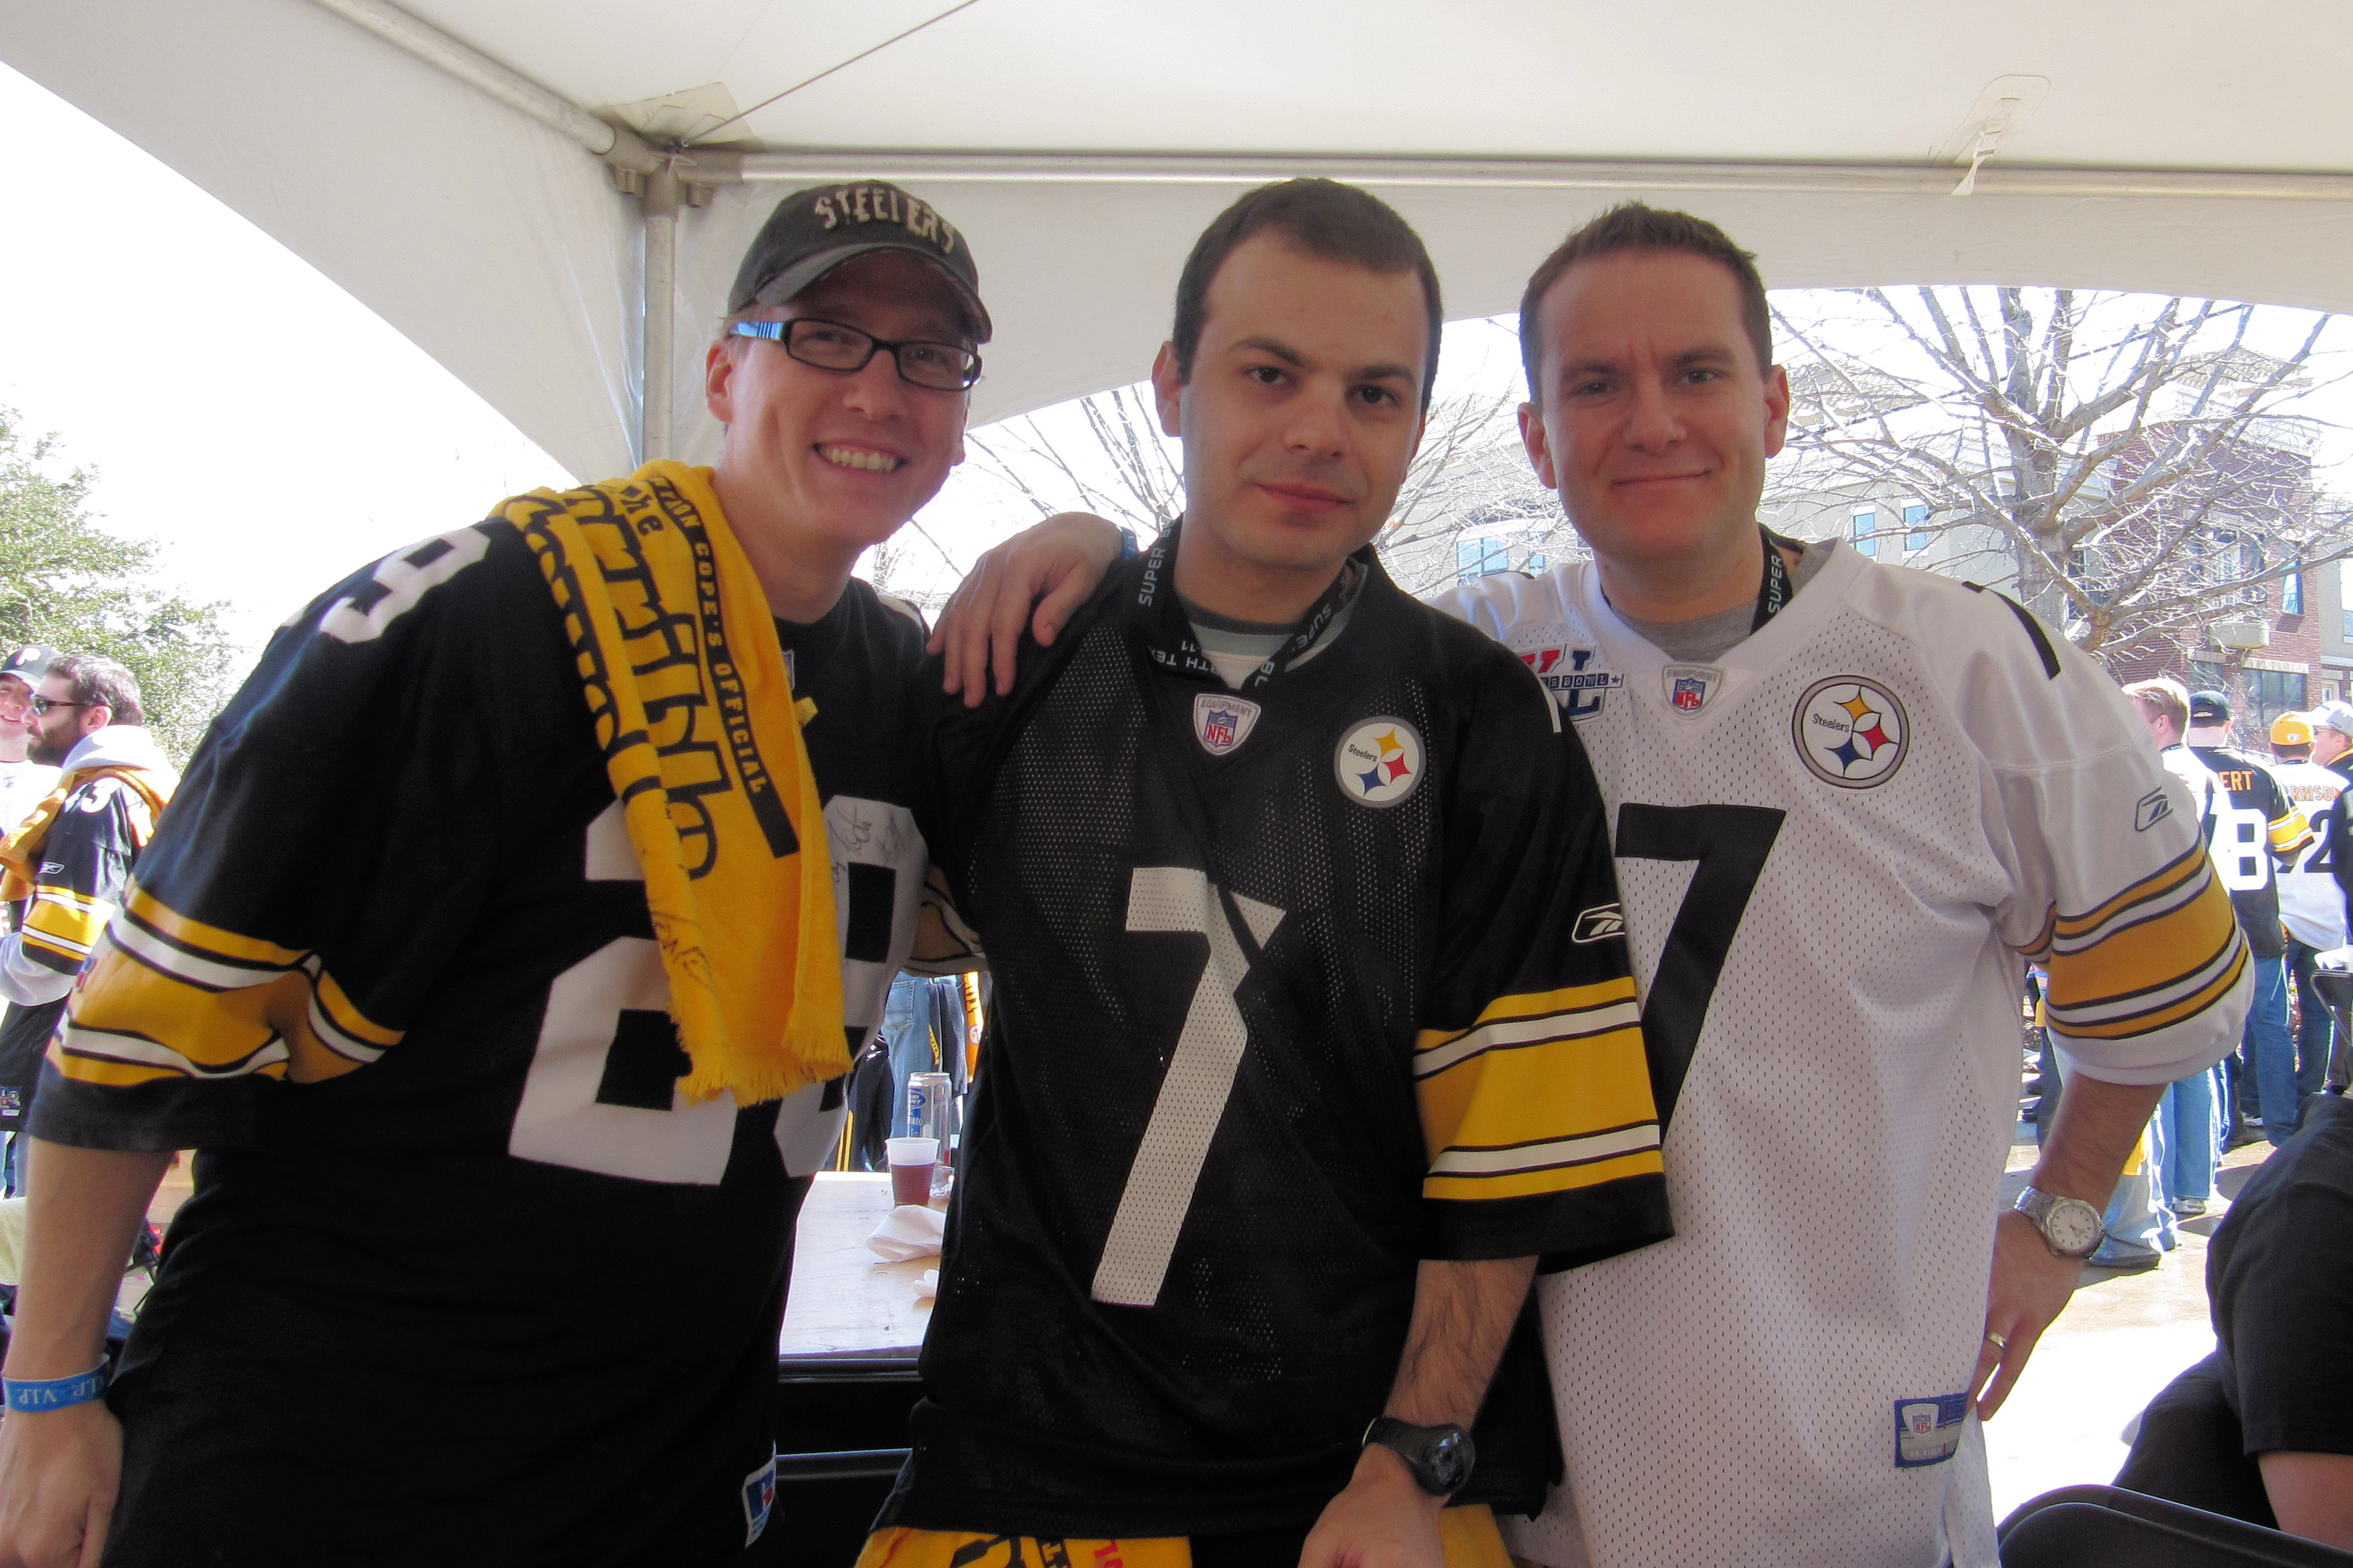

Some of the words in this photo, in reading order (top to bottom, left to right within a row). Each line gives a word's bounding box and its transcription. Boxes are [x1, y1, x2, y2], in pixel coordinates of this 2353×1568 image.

[1138, 547, 1166, 607] SUPER
[1768, 554, 1782, 613] SUPER
[1293, 603, 1332, 652] SUPE
[695, 542, 723, 647] COPE'S
[714, 663, 767, 794] OFFICIAL
[1207, 724, 1232, 744] NFL
[1348, 743, 1378, 762] Steelers
[1812, 713, 1850, 733] Steelers
[2220, 770, 2253, 792] ERT
[2225, 808, 2268, 891] 8
[2304, 809, 2334, 873] 2
[1615, 802, 1786, 1149] 7
[1091, 867, 1288, 1307] 7
[1915, 1423, 1931, 1432] NFL
